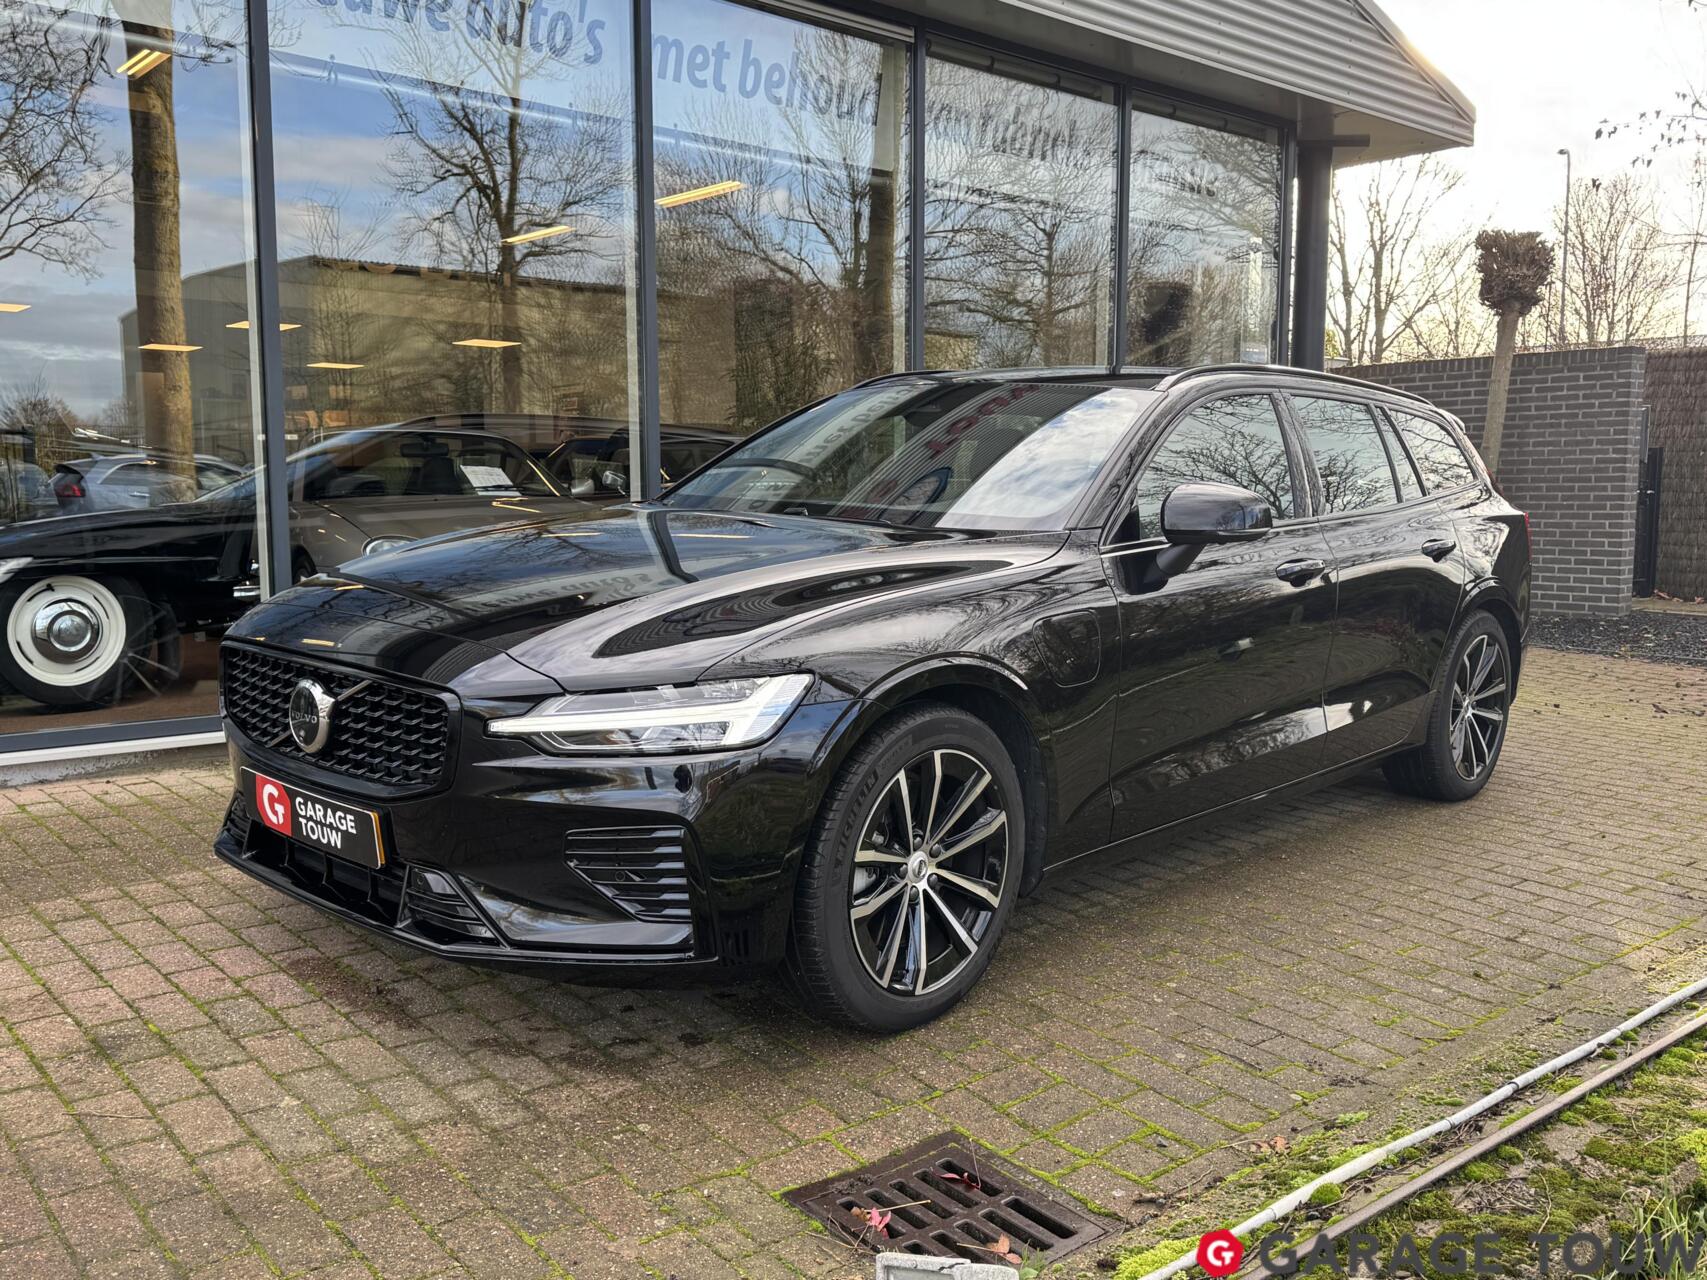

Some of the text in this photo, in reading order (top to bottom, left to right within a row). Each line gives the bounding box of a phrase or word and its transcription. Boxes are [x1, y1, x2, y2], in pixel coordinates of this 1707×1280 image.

[653, 34, 730, 93] met
[738, 38, 883, 127] behoud
[291, 711, 317, 724] VOLVO
[295, 797, 357, 834] GARAGE
[299, 817, 342, 849] TOUW
